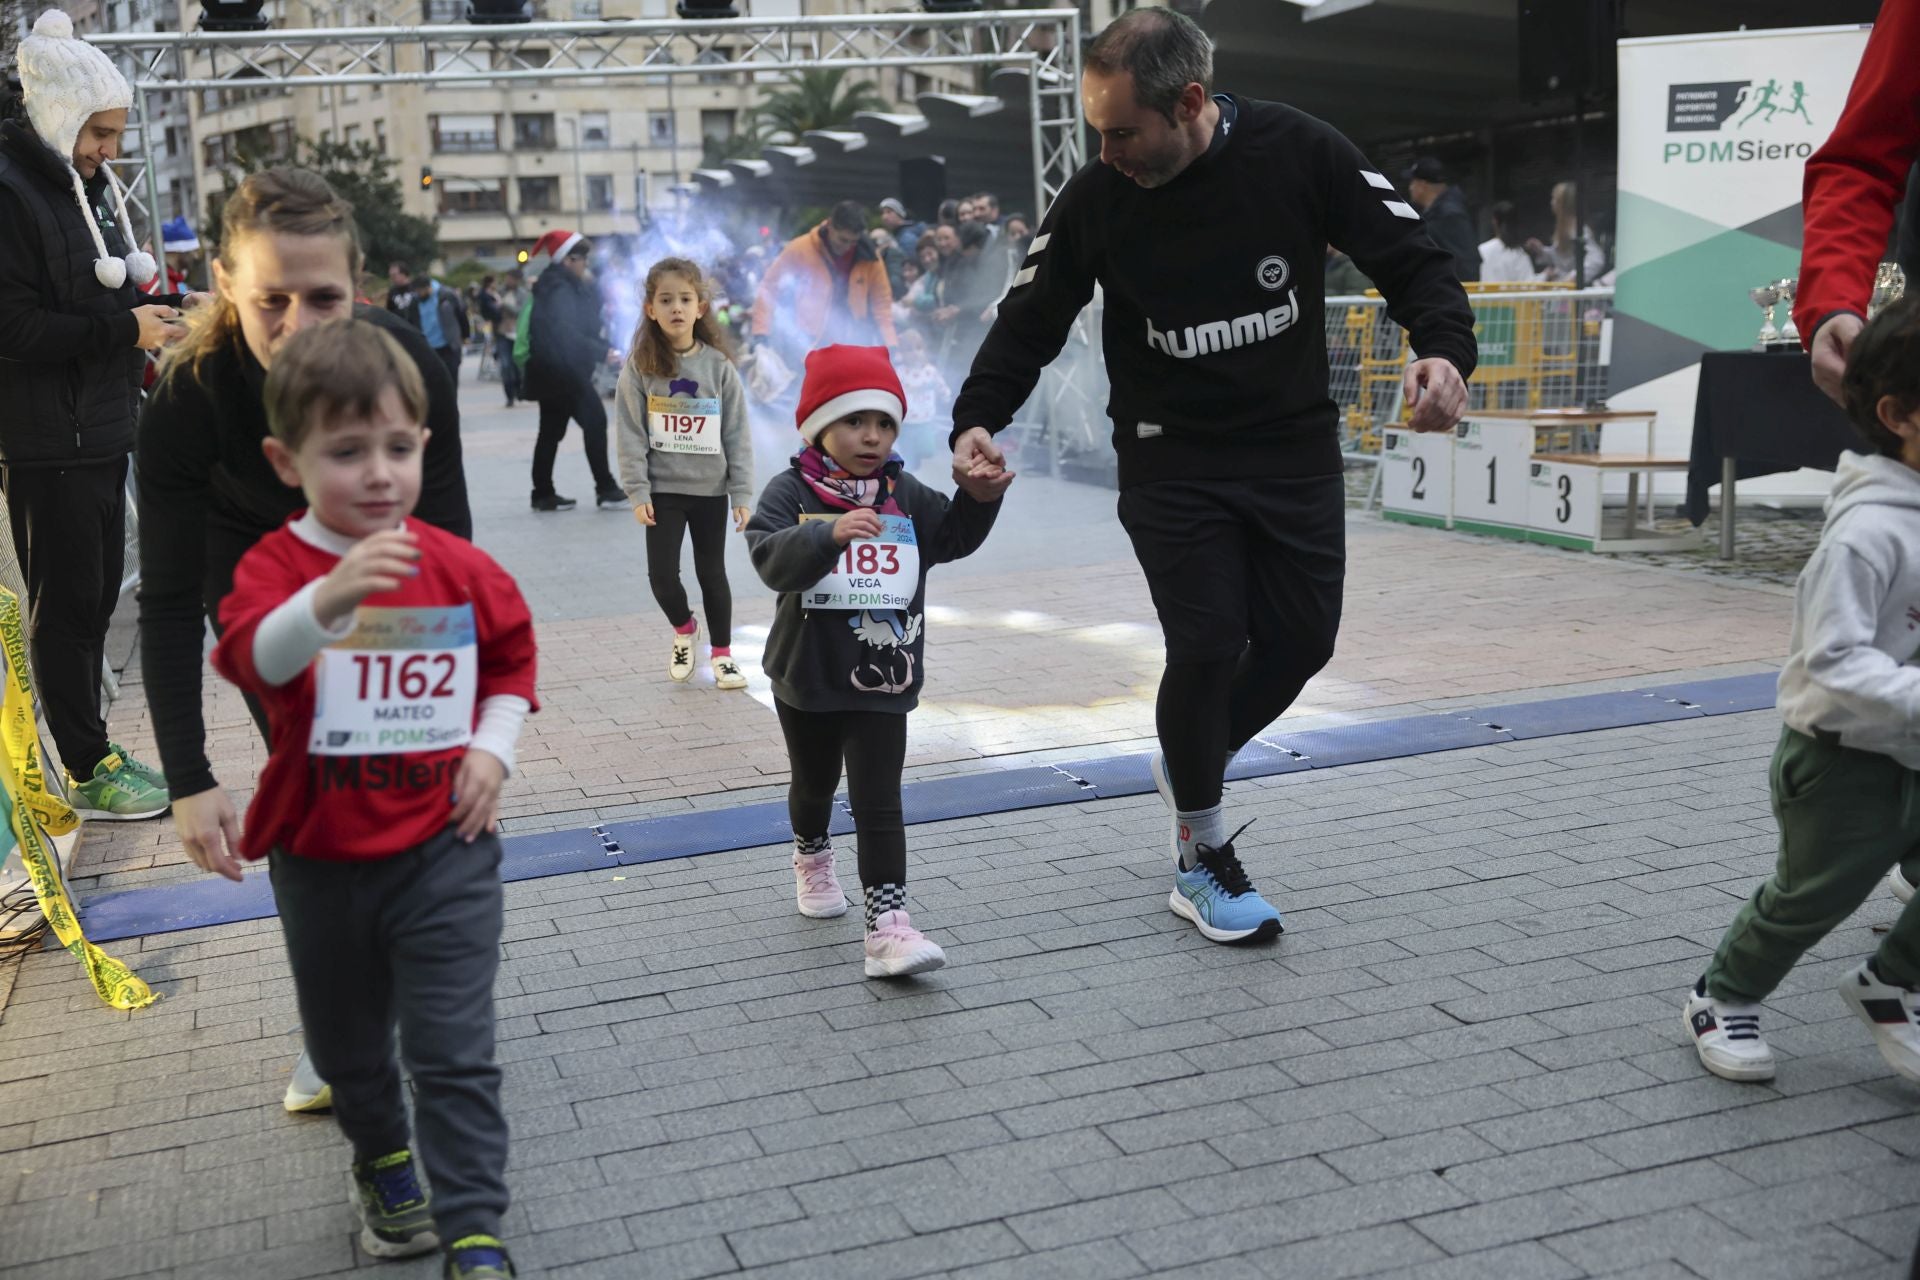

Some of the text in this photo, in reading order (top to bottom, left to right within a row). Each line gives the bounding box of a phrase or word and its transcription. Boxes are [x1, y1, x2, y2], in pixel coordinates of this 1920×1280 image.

[1664, 140, 1812, 163] PDMSiero
[1146, 286, 1299, 359] hummel
[662, 414, 706, 434] 1197
[673, 443, 713, 452] PDMSiero
[1412, 456, 1426, 500] 2
[1486, 456, 1497, 504] 1
[1557, 474, 1571, 523] 3
[848, 578, 882, 588] VEGA
[848, 593, 910, 606] PDMSiero
[352, 654, 457, 700] 1162
[373, 705, 435, 721] MATEO
